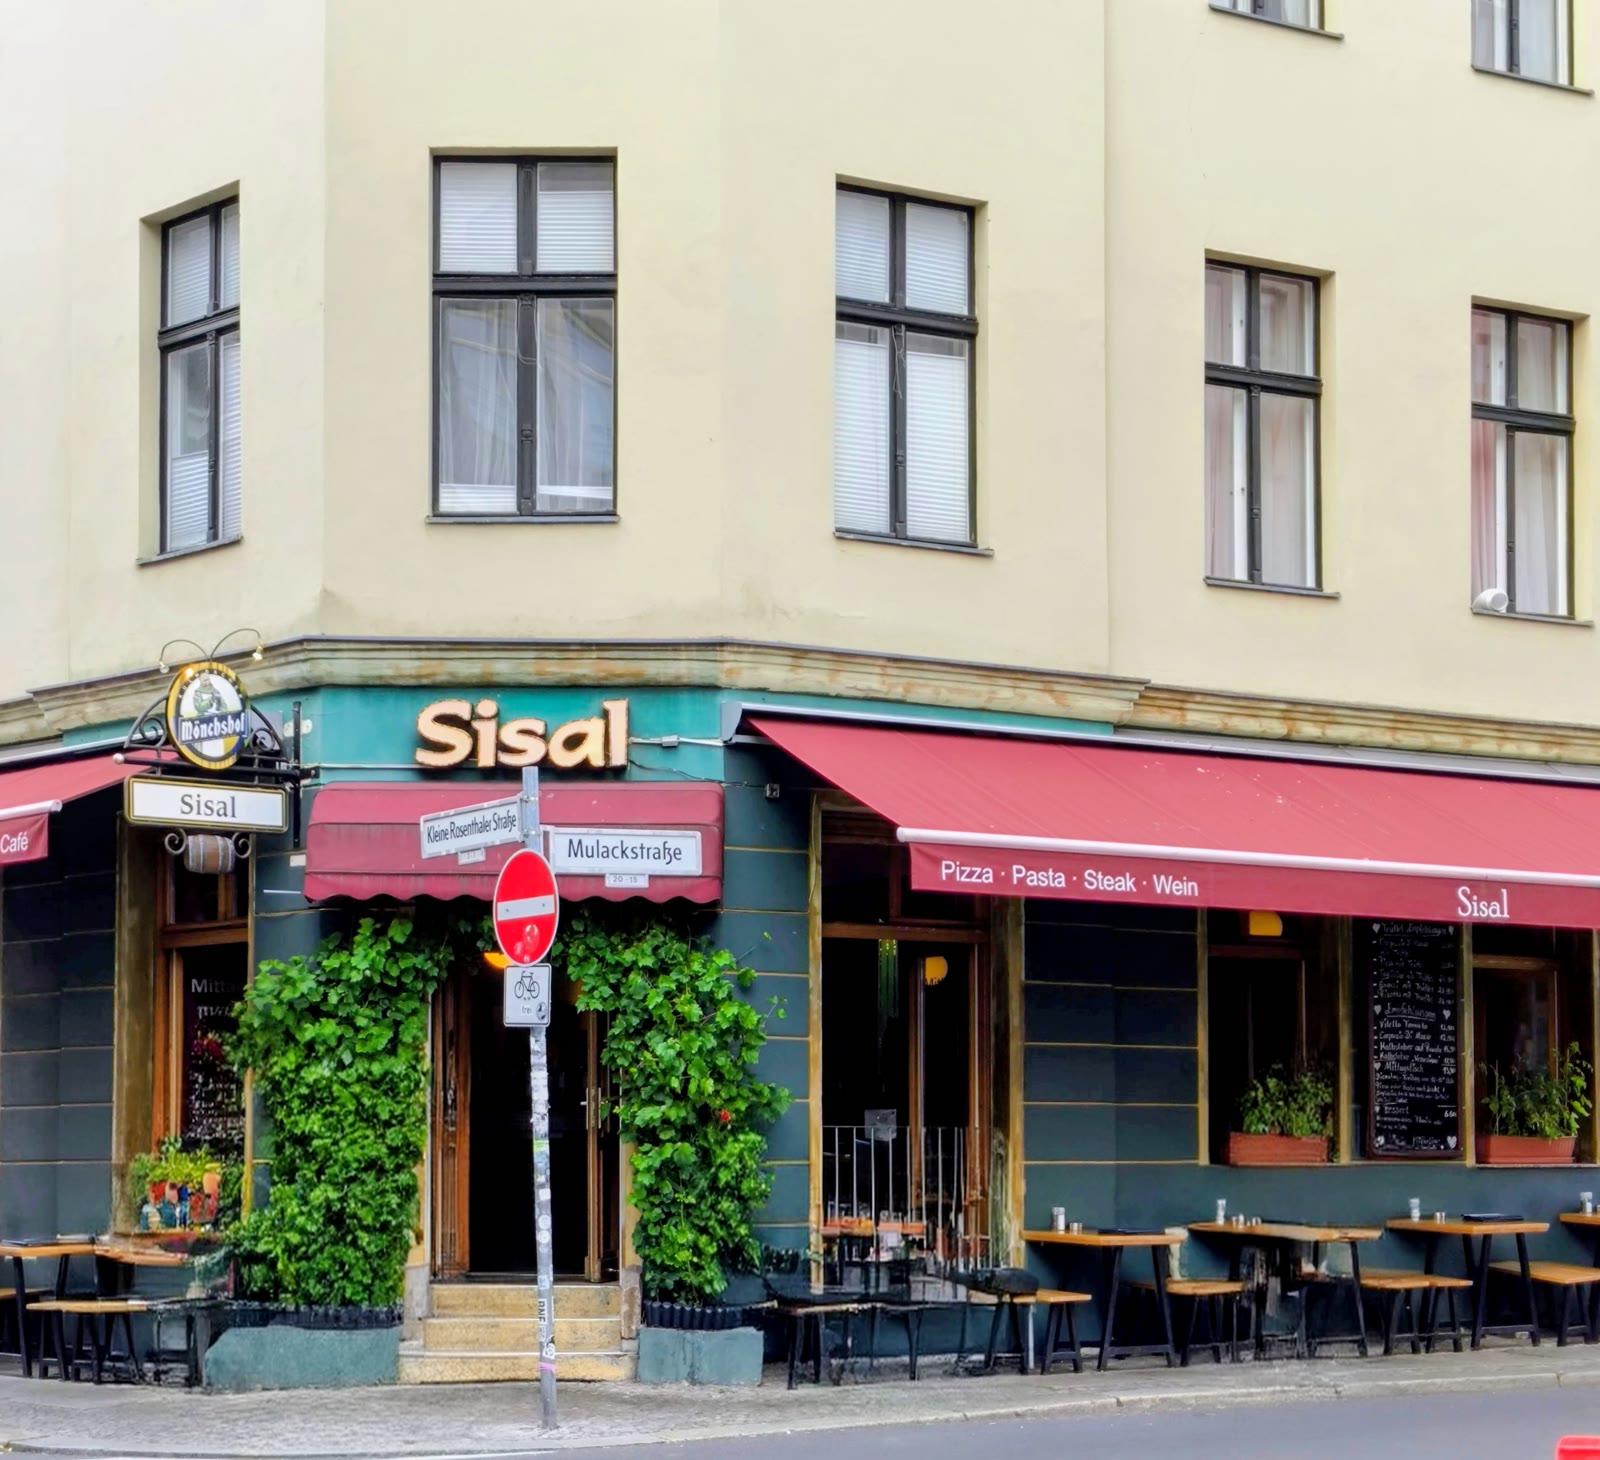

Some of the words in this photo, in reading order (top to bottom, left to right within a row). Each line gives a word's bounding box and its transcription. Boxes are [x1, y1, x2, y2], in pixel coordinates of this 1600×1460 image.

[181, 712, 246, 741] Mönchshof
[415, 698, 629, 769] Sisal
[180, 793, 237, 818] Sisal
[427, 825, 449, 844] Kleine
[450, 815, 492, 839] Rosenthaler
[493, 810, 517, 832] Straße
[0, 832, 29, 853] Café
[568, 838, 682, 865] Mulackstraße
[941, 860, 994, 883] Pizza
[1012, 864, 1066, 888] Pasta
[1084, 869, 1137, 892] Steak
[1152, 874, 1199, 897] Wein
[1457, 886, 1510, 918] Sisal
